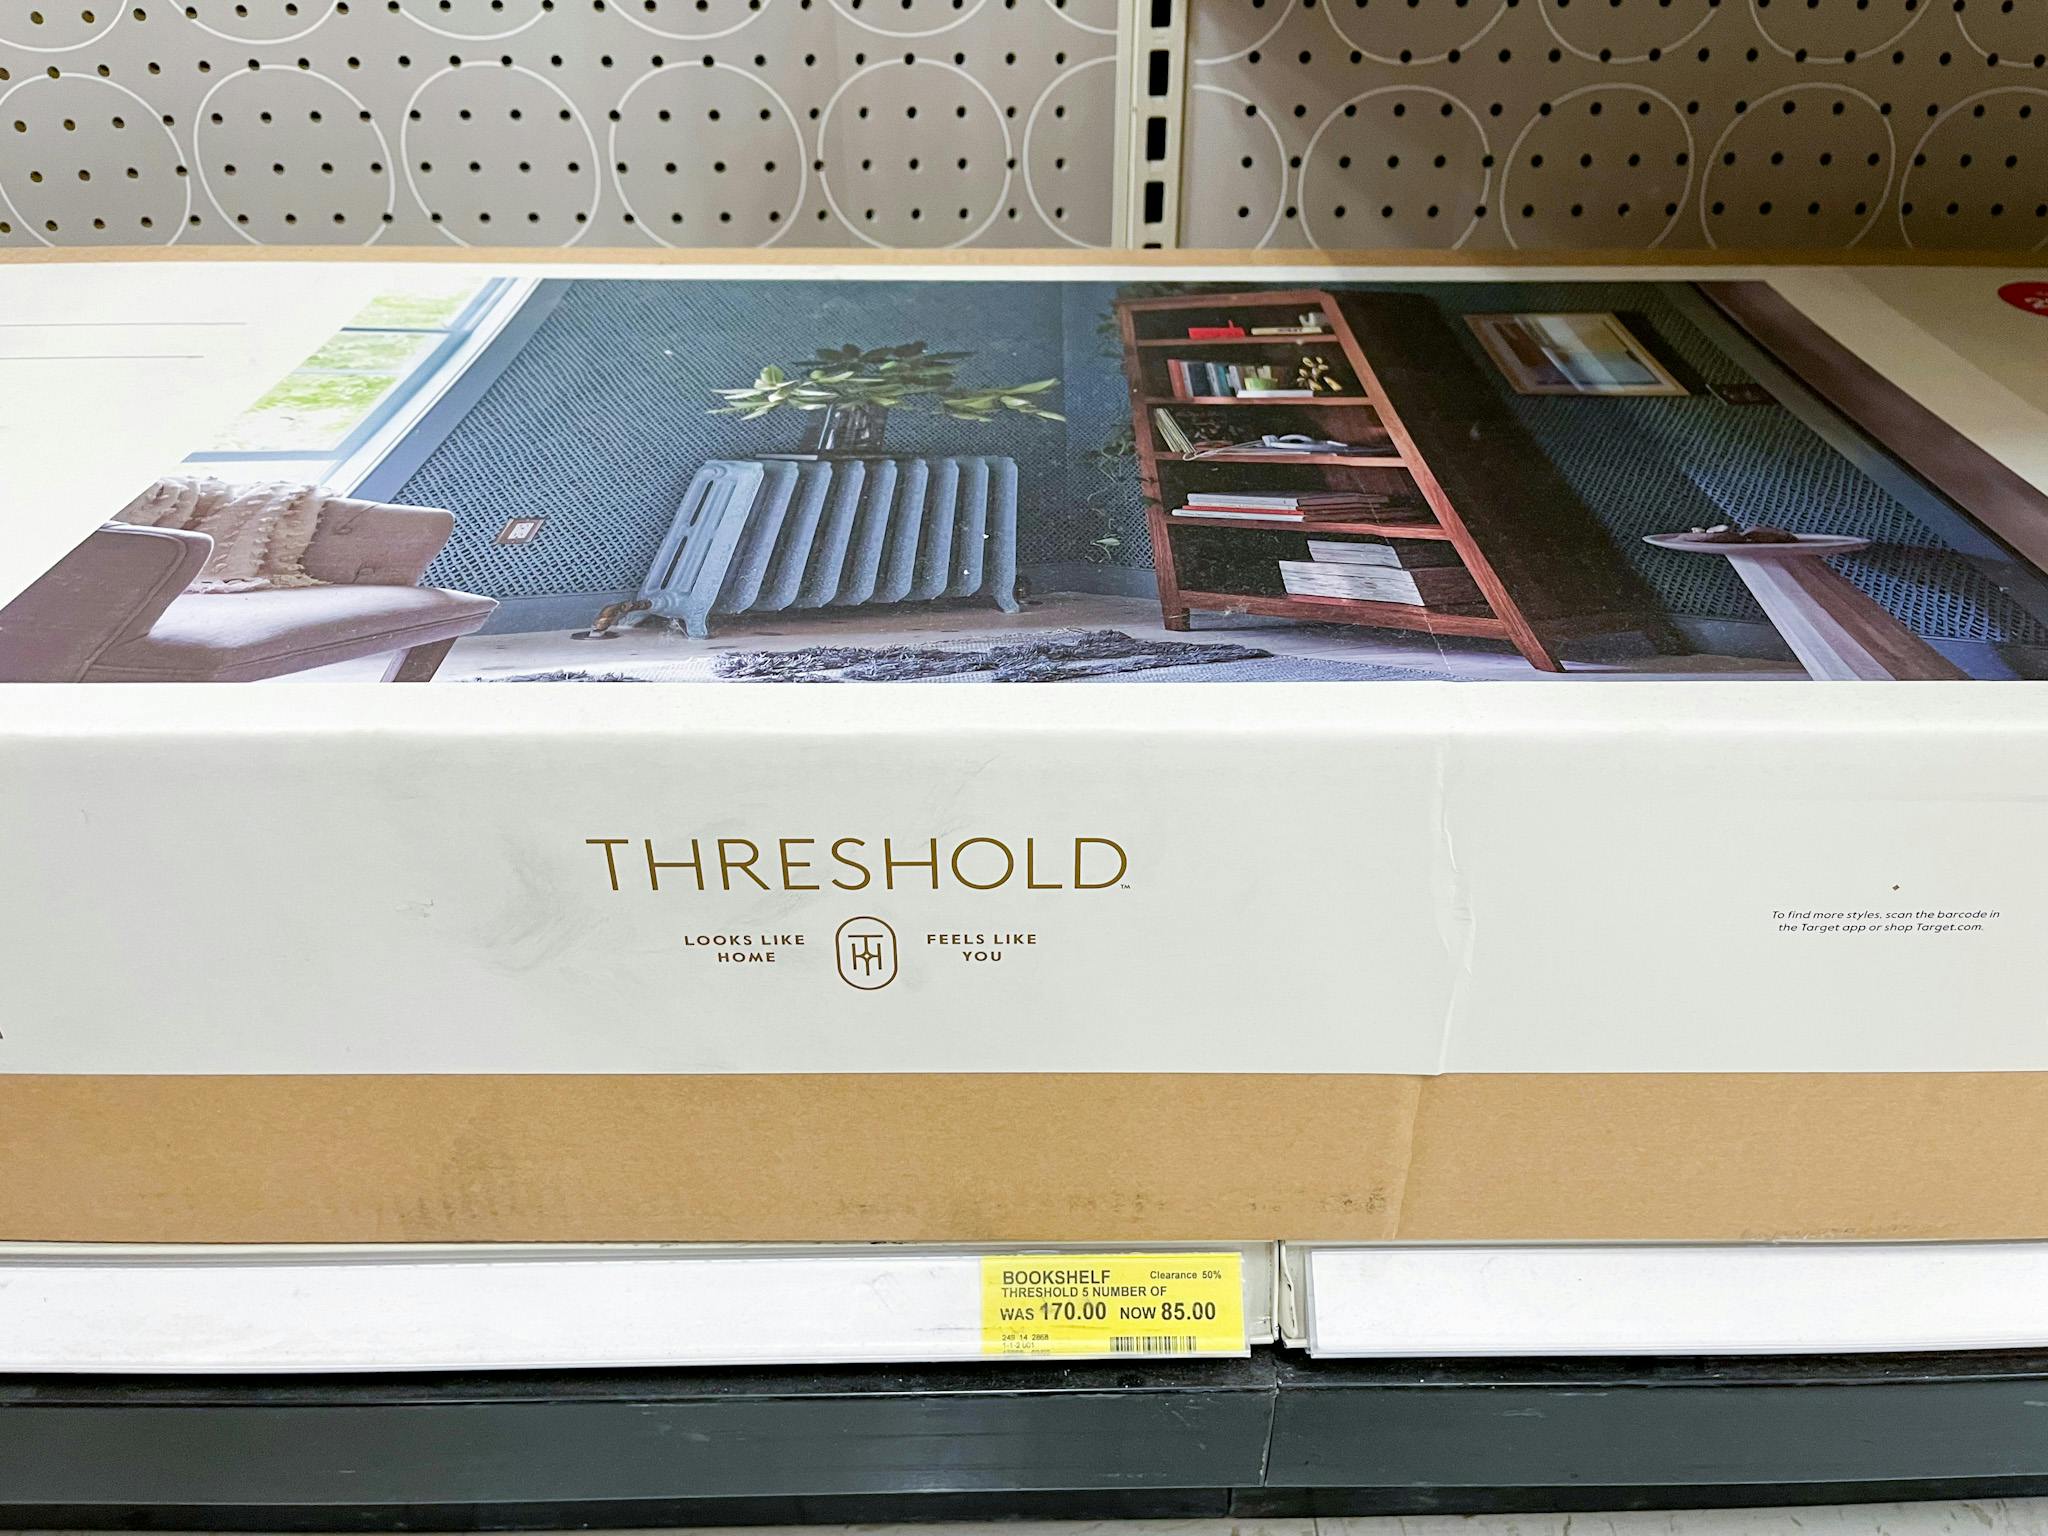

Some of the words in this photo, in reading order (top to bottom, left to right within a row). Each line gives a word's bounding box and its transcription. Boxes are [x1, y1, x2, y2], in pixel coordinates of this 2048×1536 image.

[586, 837, 1128, 891] THRESHOLD
[1772, 910, 1785, 919] To
[1787, 910, 1811, 919] find
[1813, 911, 1844, 919] more
[1885, 911, 1913, 919] scan
[1915, 910, 1935, 919] the
[1937, 910, 1987, 919] barcode
[1989, 910, 2001, 918] in
[1778, 923, 1798, 932] the
[1801, 923, 1840, 933] Target
[1842, 924, 1866, 933] app
[1884, 923, 1913, 933] shop
[1916, 923, 1985, 933] Target.com.
[684, 934, 753, 947] LOOKS
[760, 934, 806, 946] LIKE
[926, 933, 986, 945] FEELS
[993, 933, 1037, 945] LIKE
[717, 952, 776, 963] HOME
[961, 951, 1002, 962] YOU
[1002, 1270, 1111, 1285] BOOKSHELF
[1149, 1271, 1198, 1280] Clearance
[1202, 1271, 1222, 1280] 50%
[1001, 1287, 1079, 1298] THRESHOLD
[1082, 1287, 1089, 1297] 5
[1092, 1286, 1147, 1297] NUMBER
[1150, 1286, 1168, 1296] OF
[1000, 1308, 1035, 1321] WAS
[1039, 1302, 1107, 1320] 170.00
[1120, 1307, 1156, 1320] NOW
[1161, 1302, 1216, 1320] 85.00
